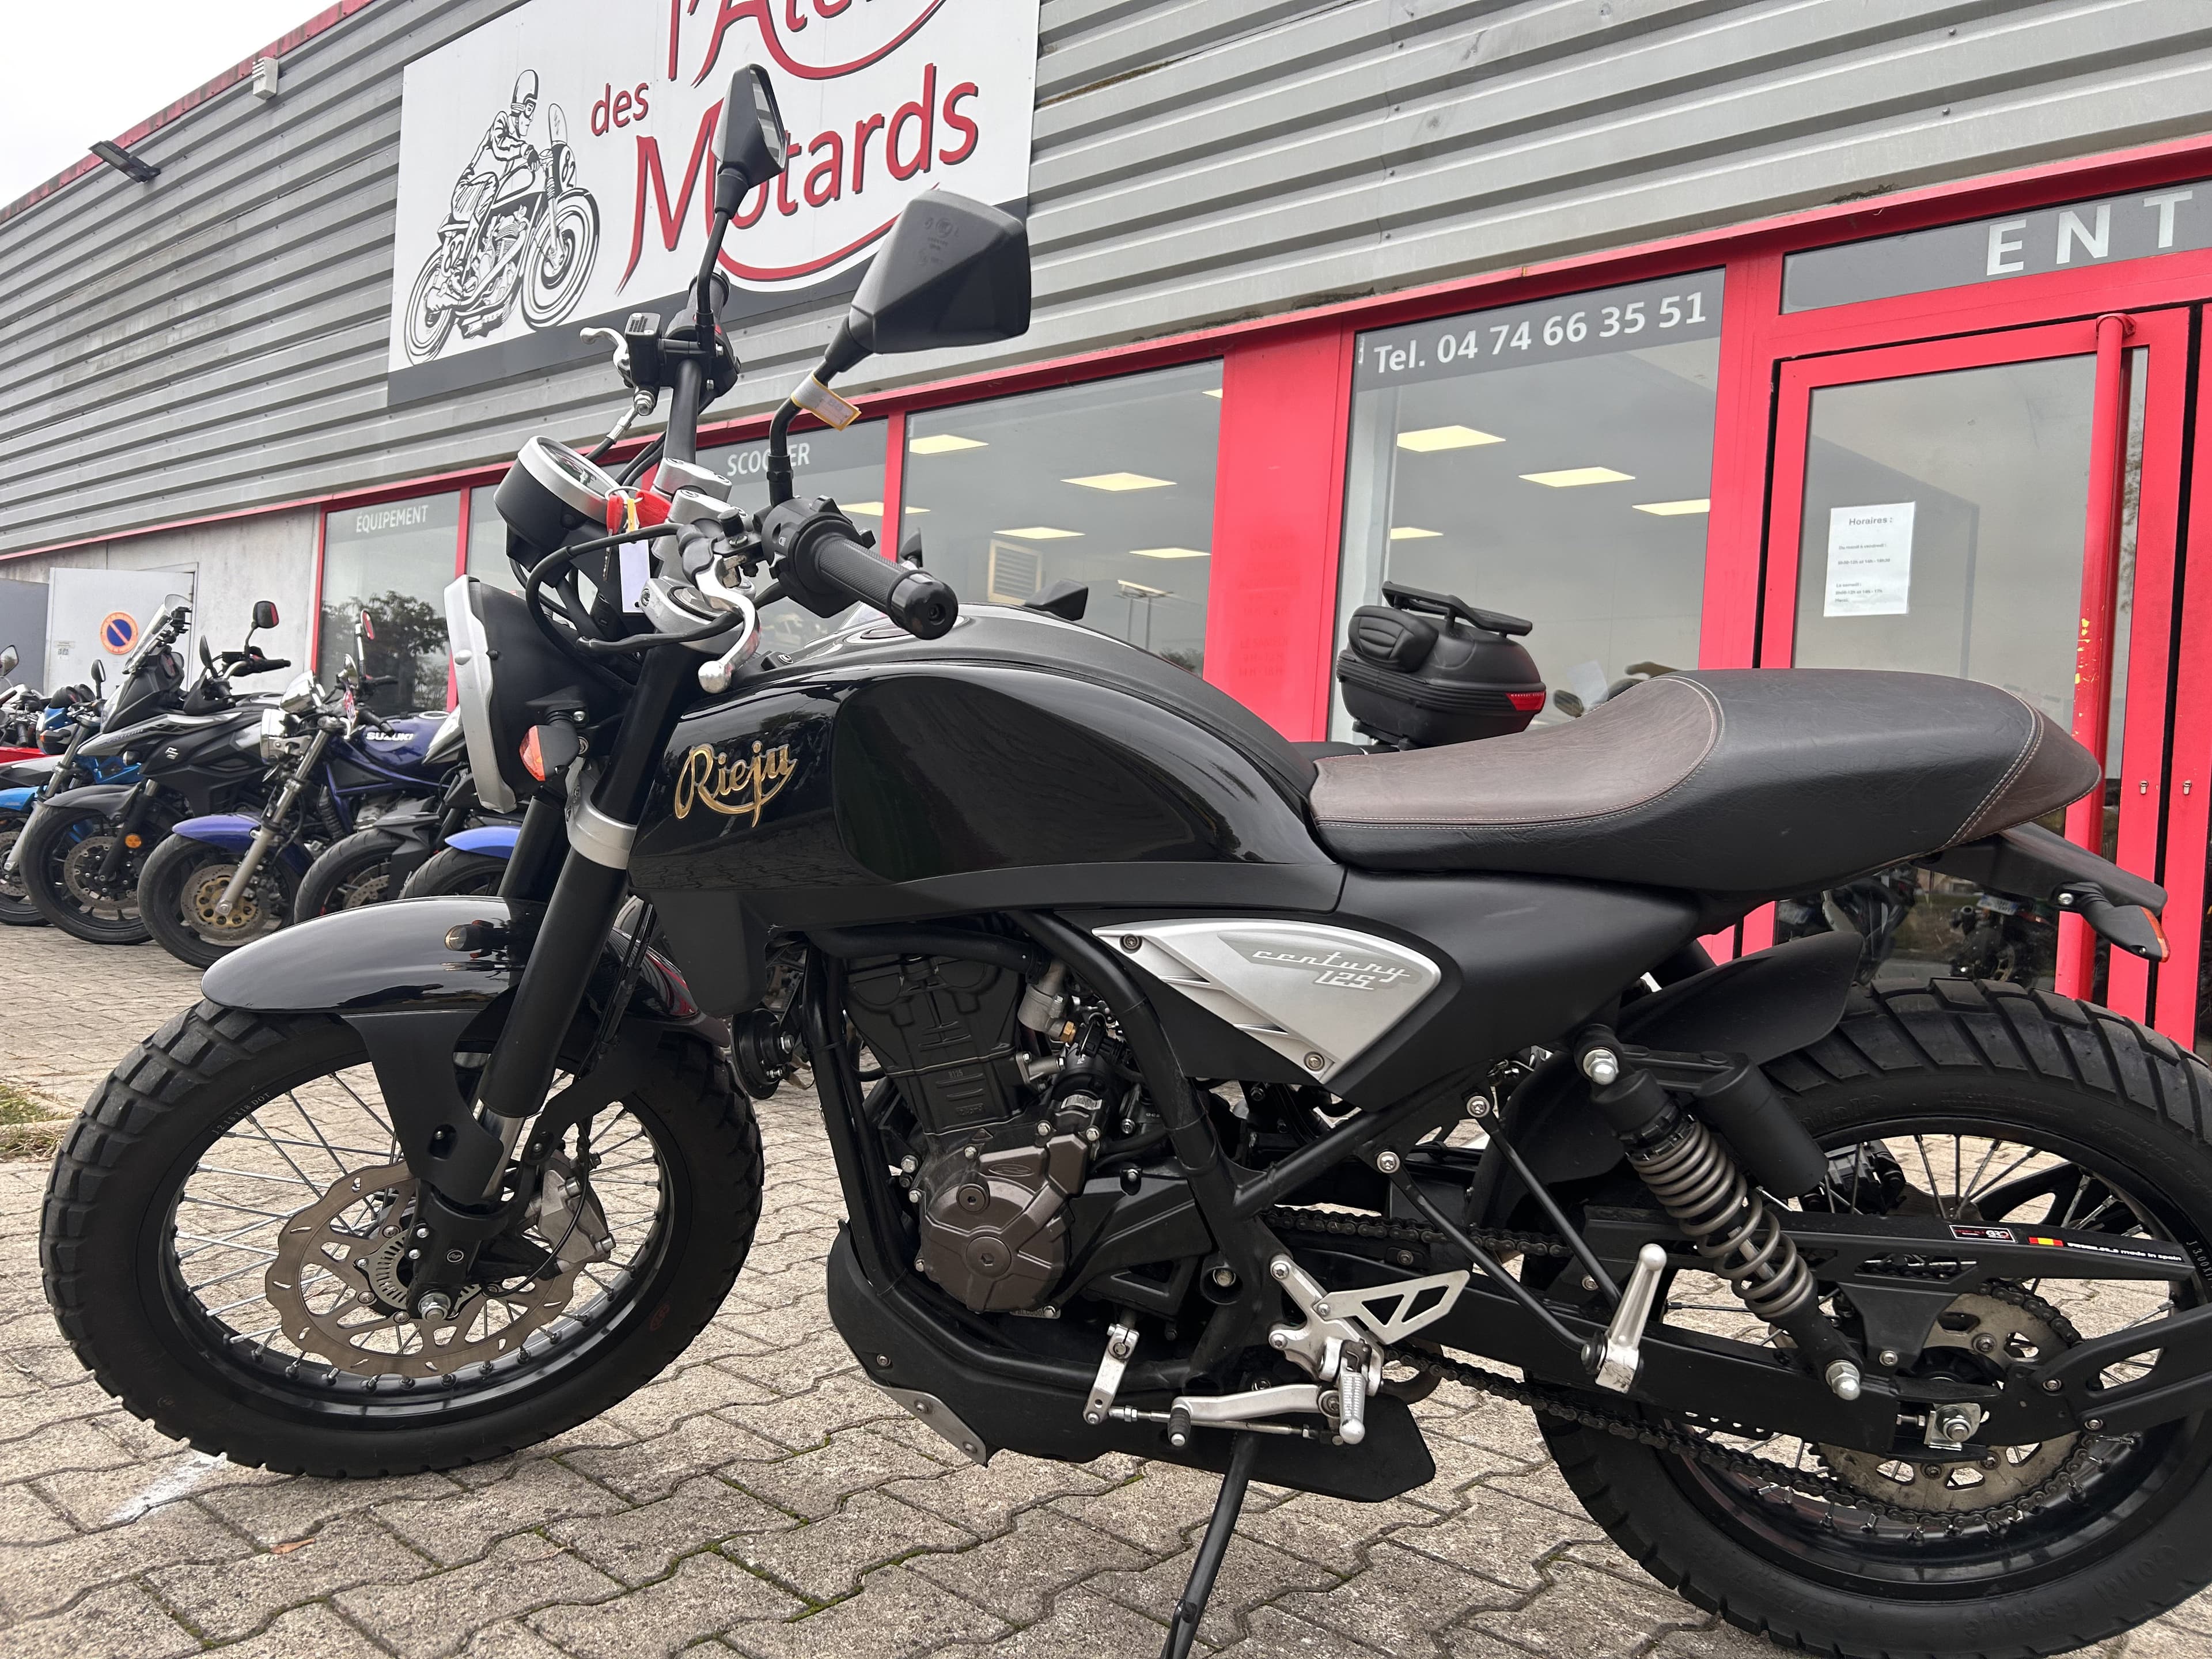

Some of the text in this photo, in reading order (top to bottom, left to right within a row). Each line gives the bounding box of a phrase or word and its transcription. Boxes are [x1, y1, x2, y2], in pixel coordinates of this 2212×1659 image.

[590, 82, 649, 137] des
[1986, 190, 2193, 276] ENT
[1374, 291, 1706, 373] Tel. 04 74 66 35 51
[726, 442, 810, 477] SCOOER
[366, 731, 414, 741] SUZUKI
[675, 740, 798, 828] Rieju
[1252, 950, 1411, 983] century
[1314, 970, 1376, 990] 125
[251, 1092, 271, 1106] DOT
